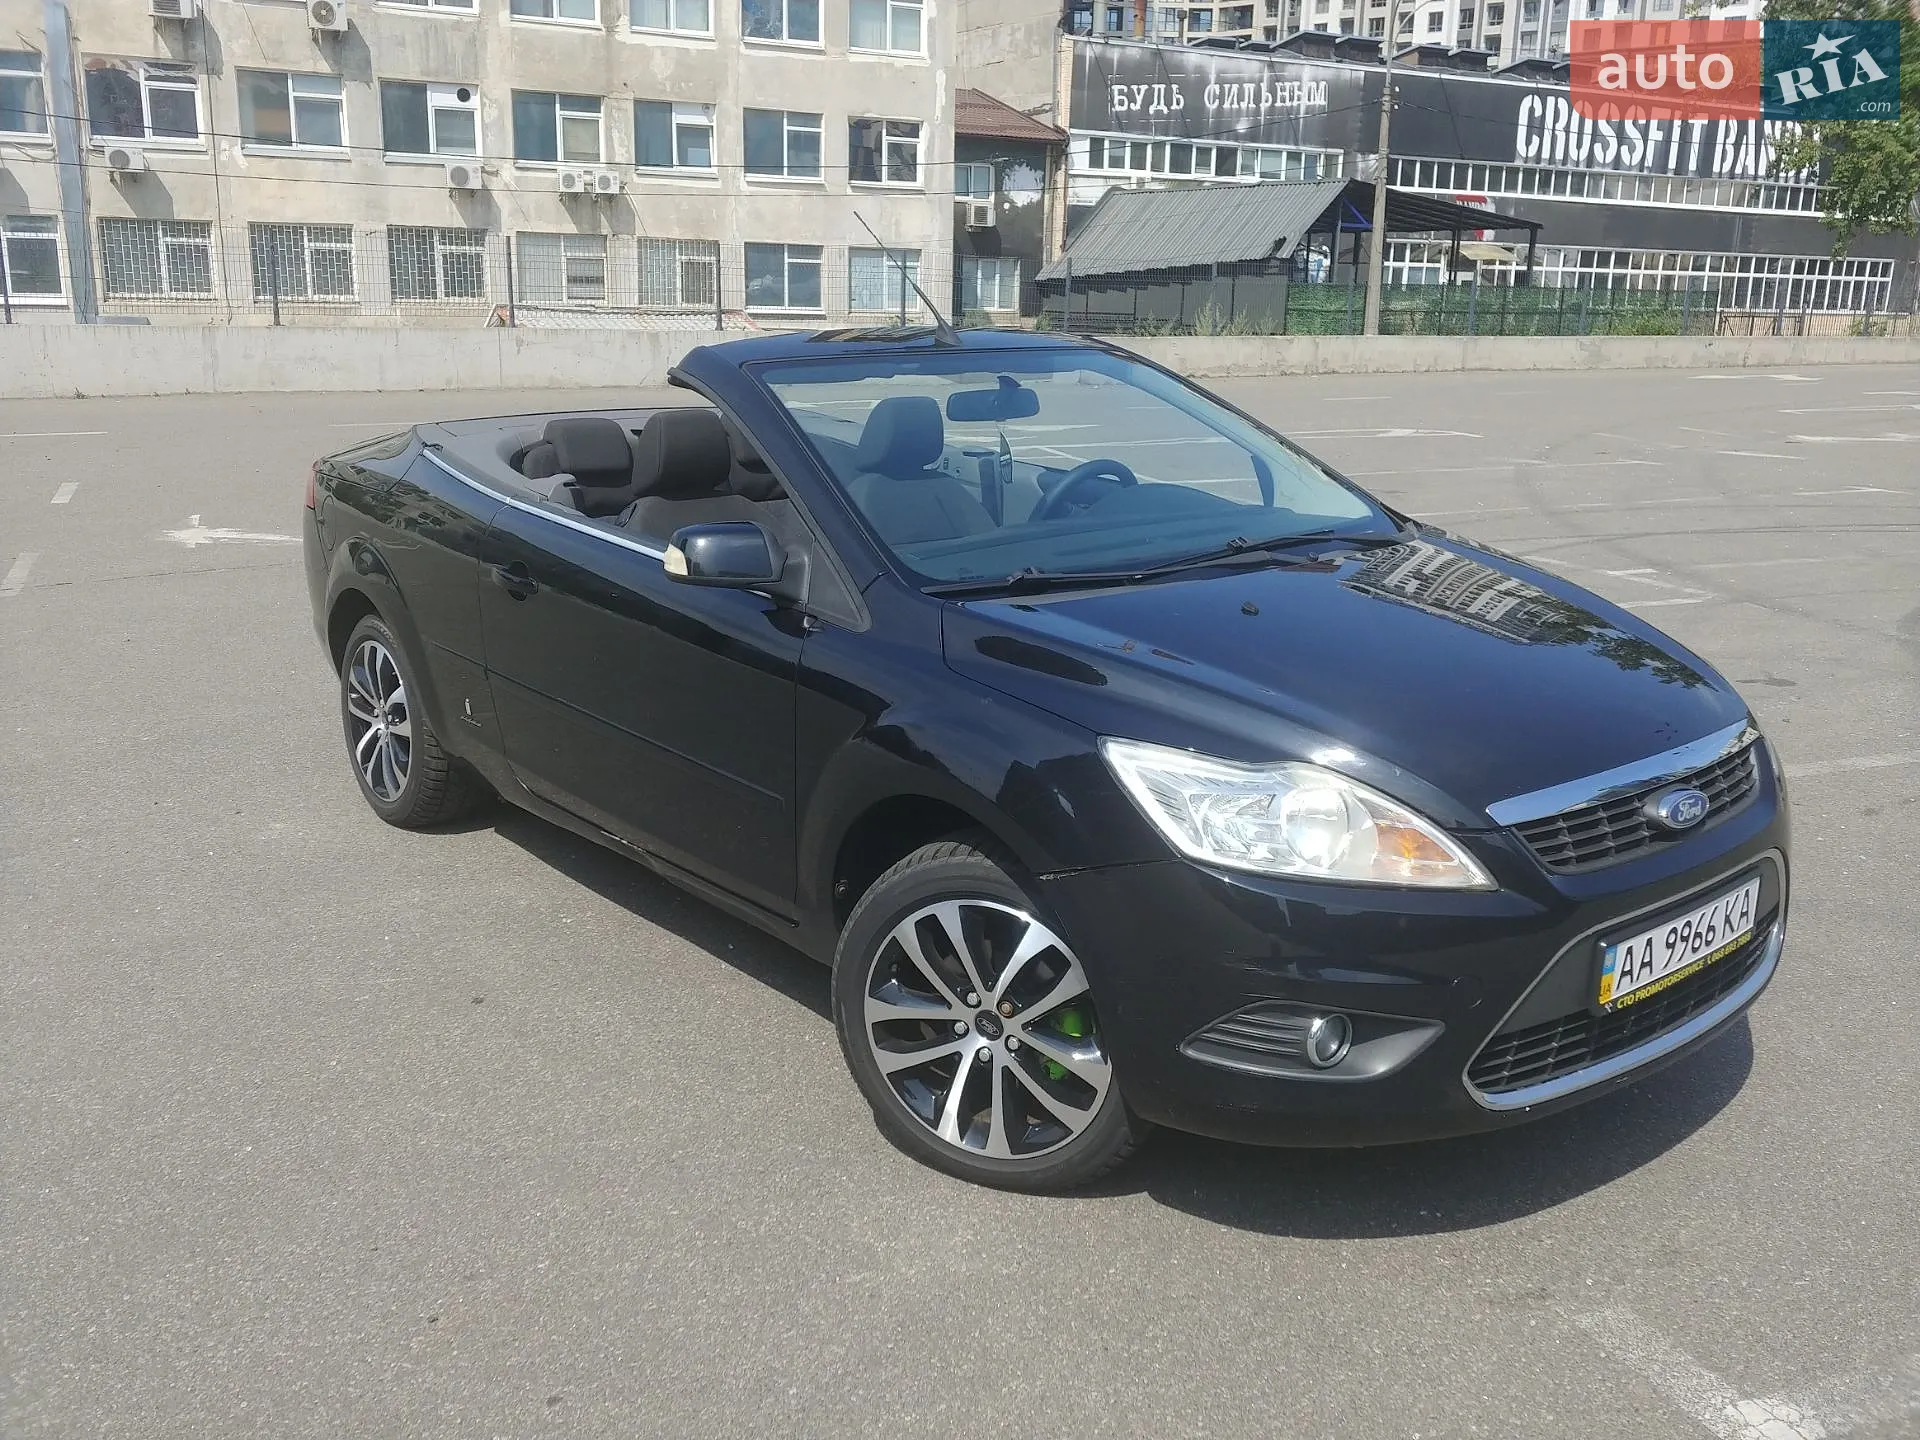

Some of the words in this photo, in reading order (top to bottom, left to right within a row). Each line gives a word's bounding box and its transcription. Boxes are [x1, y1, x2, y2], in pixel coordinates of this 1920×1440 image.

[1111, 83, 1185, 115] БУДЬ
[1203, 80, 1329, 109] СИЛЬНЫМ
[1515, 94, 1709, 172] CROSSFIT
[1678, 798, 1702, 822] Ford
[1616, 936, 1653, 991] AA
[1661, 904, 1719, 970] 9966
[1722, 887, 1751, 941] KA
